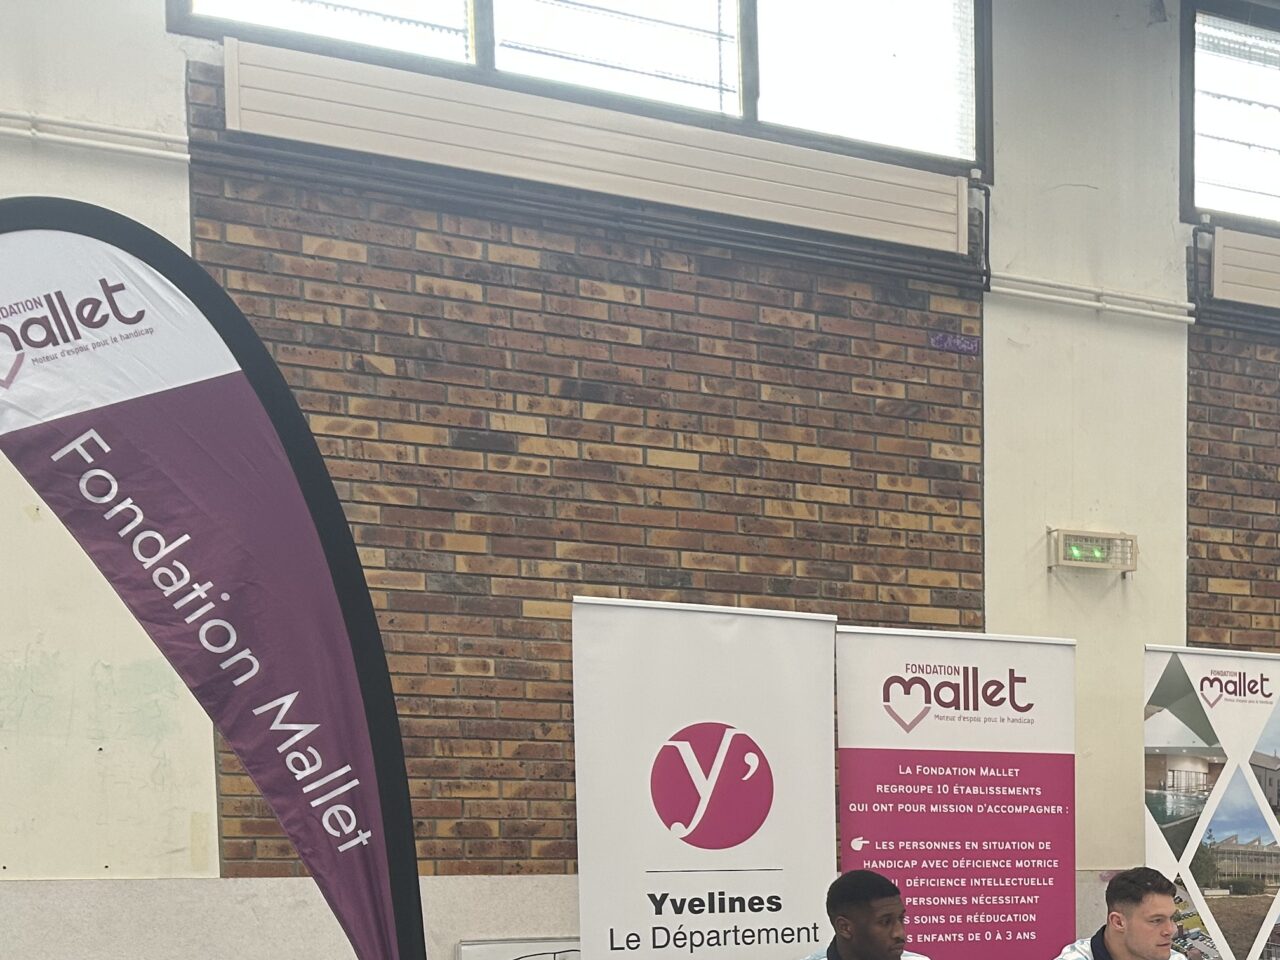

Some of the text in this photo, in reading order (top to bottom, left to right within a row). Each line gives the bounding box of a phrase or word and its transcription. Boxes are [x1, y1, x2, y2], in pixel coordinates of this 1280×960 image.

[0, 296, 44, 319] DATION
[110, 335, 118, 344] le
[120, 327, 155, 341] handicap
[50, 428, 260, 687] Fondation
[905, 663, 960, 676] FONDATION
[883, 666, 1035, 713] mallet
[1200, 671, 1273, 698] mallet
[252, 690, 372, 853] Mallet
[916, 765, 976, 776] FONDATION
[980, 766, 1020, 777] MALLET
[876, 784, 1042, 795] REGROUPE 10 ÉTABLISSEMENTS
[849, 803, 868, 812] QUI
[873, 803, 894, 812] ONT
[898, 804, 927, 813] POUR
[930, 804, 973, 813] MISSION
[977, 804, 1063, 814] D'ACCOMPAGNER
[875, 841, 1051, 850] LES PERSONNES EN SITUATION DE
[863, 857, 1059, 869] HANDICAP AVEC DÉFICIENCE MOTRICE
[906, 876, 966, 887] DÉFICIENCE
[970, 877, 1054, 887] INTELLECTUELLE
[647, 891, 783, 916] Yvelines
[905, 893, 1040, 906] PERSONNES NÉCESSITANT
[914, 915, 945, 924] SOINS
[949, 915, 962, 923] DE
[966, 912, 1036, 923] RÉÉDUCATION
[609, 922, 820, 954] Le Département
[917, 933, 964, 943] ENFANTS
[968, 932, 981, 941] DE
[985, 930, 991, 941] 0
[995, 929, 1002, 941] À
[1005, 930, 1012, 941] 3
[1016, 931, 1036, 940] ANS
